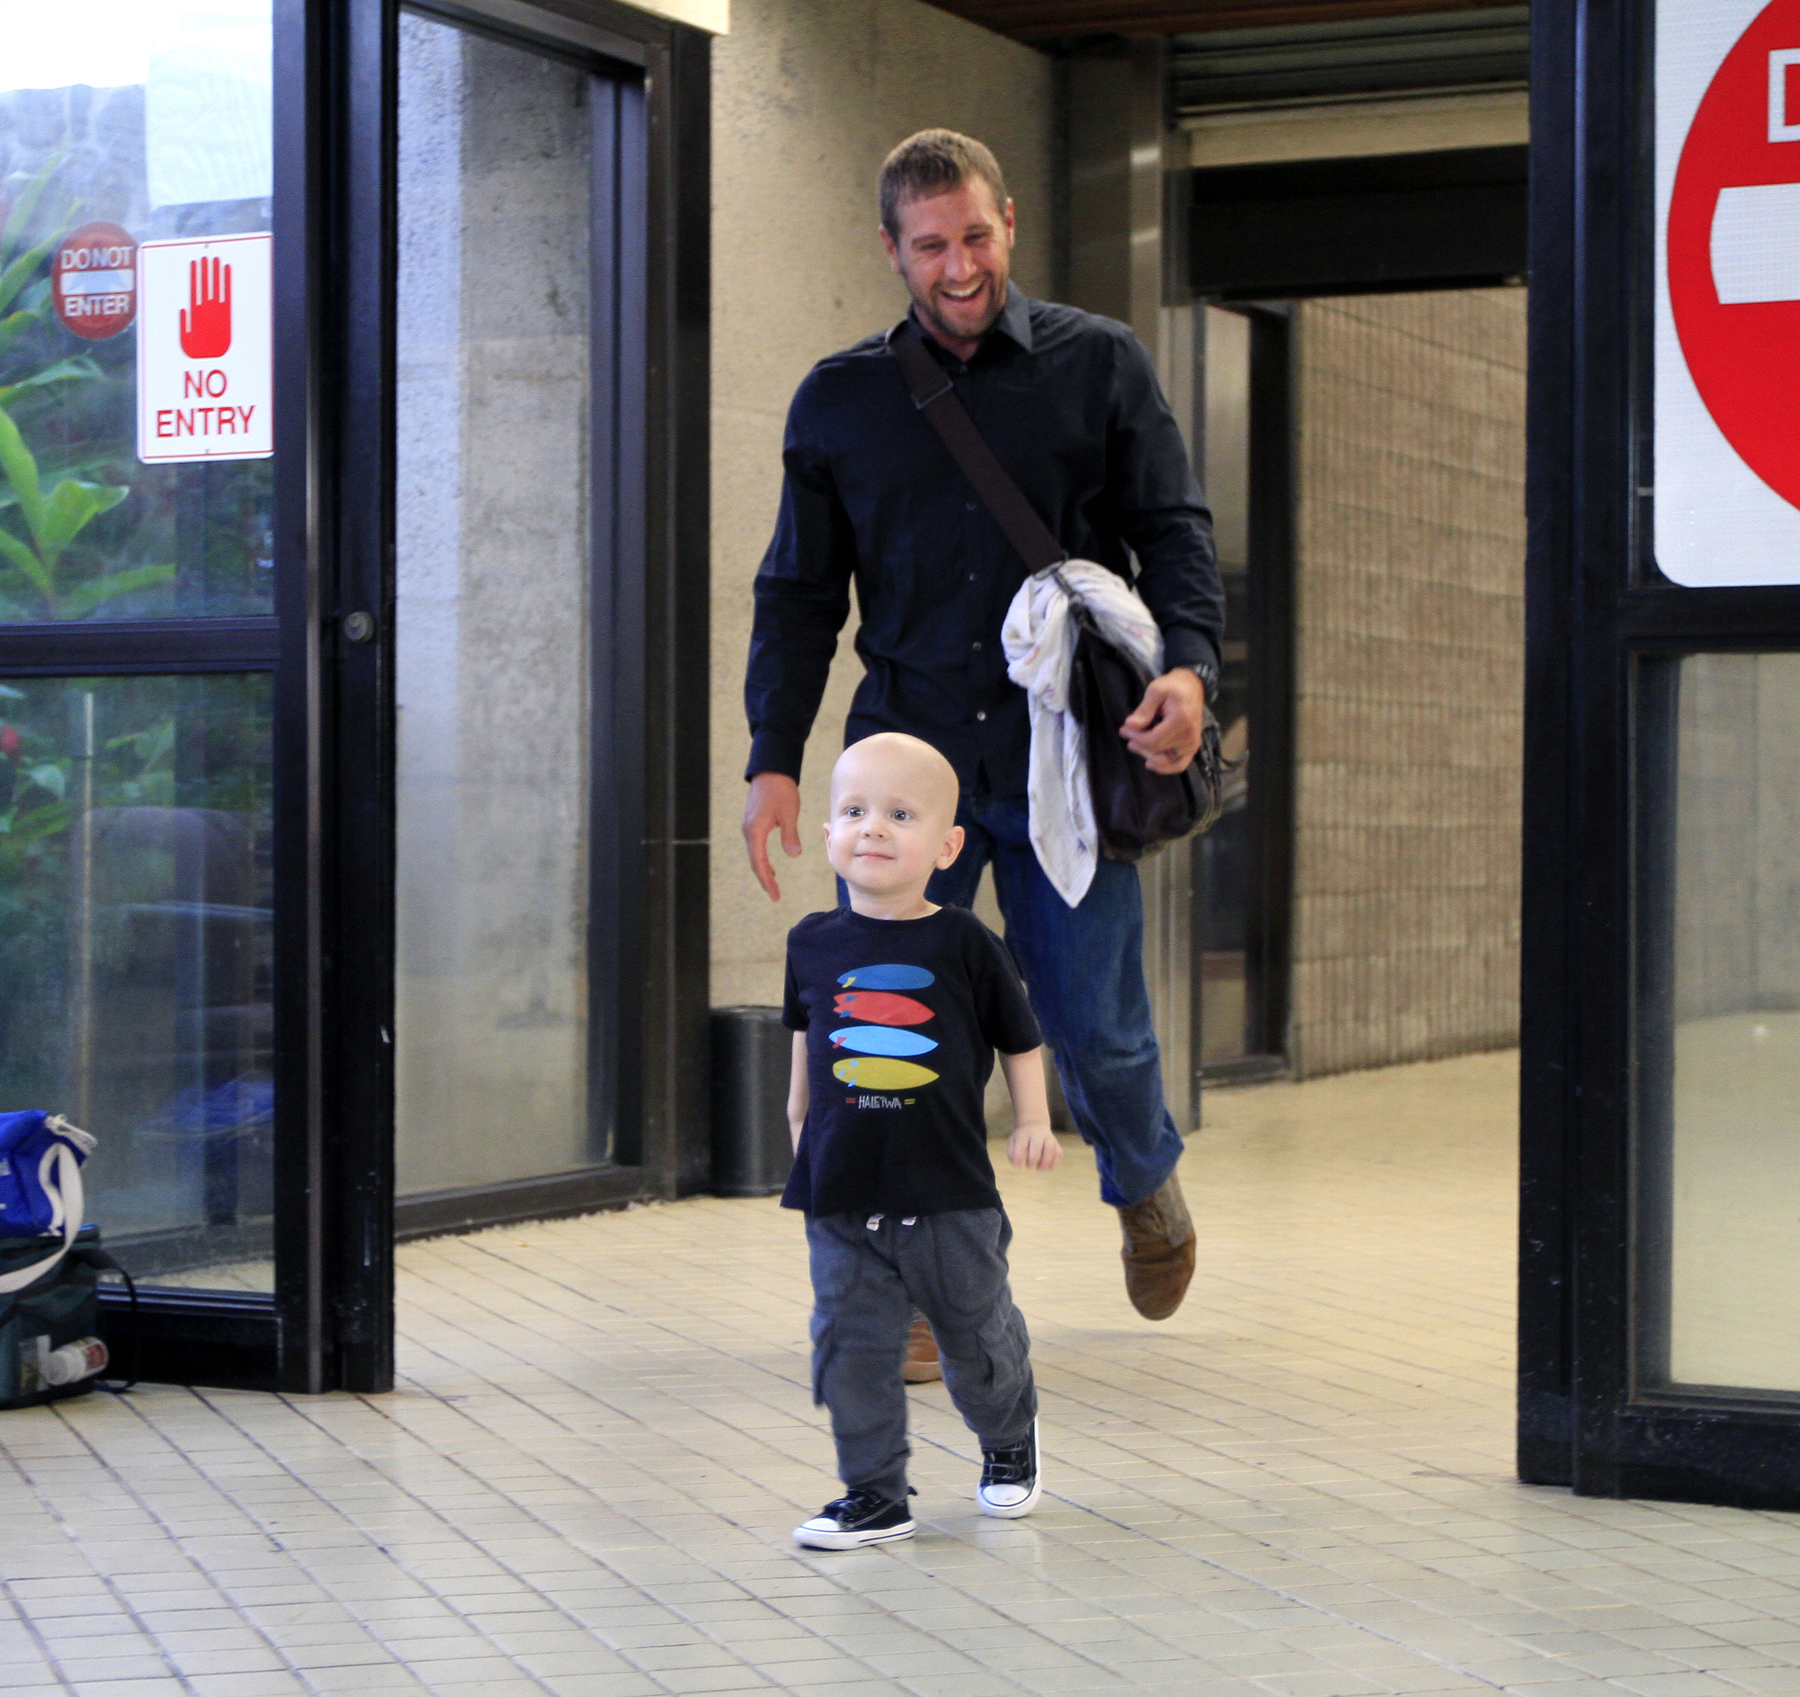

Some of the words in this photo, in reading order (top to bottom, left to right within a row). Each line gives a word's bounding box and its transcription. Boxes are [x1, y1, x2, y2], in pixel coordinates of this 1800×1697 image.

[61, 249, 90, 270] DO
[92, 245, 134, 268] NOT
[65, 294, 130, 317] ENTER
[184, 369, 228, 398] NO
[156, 405, 255, 438] ENTRY
